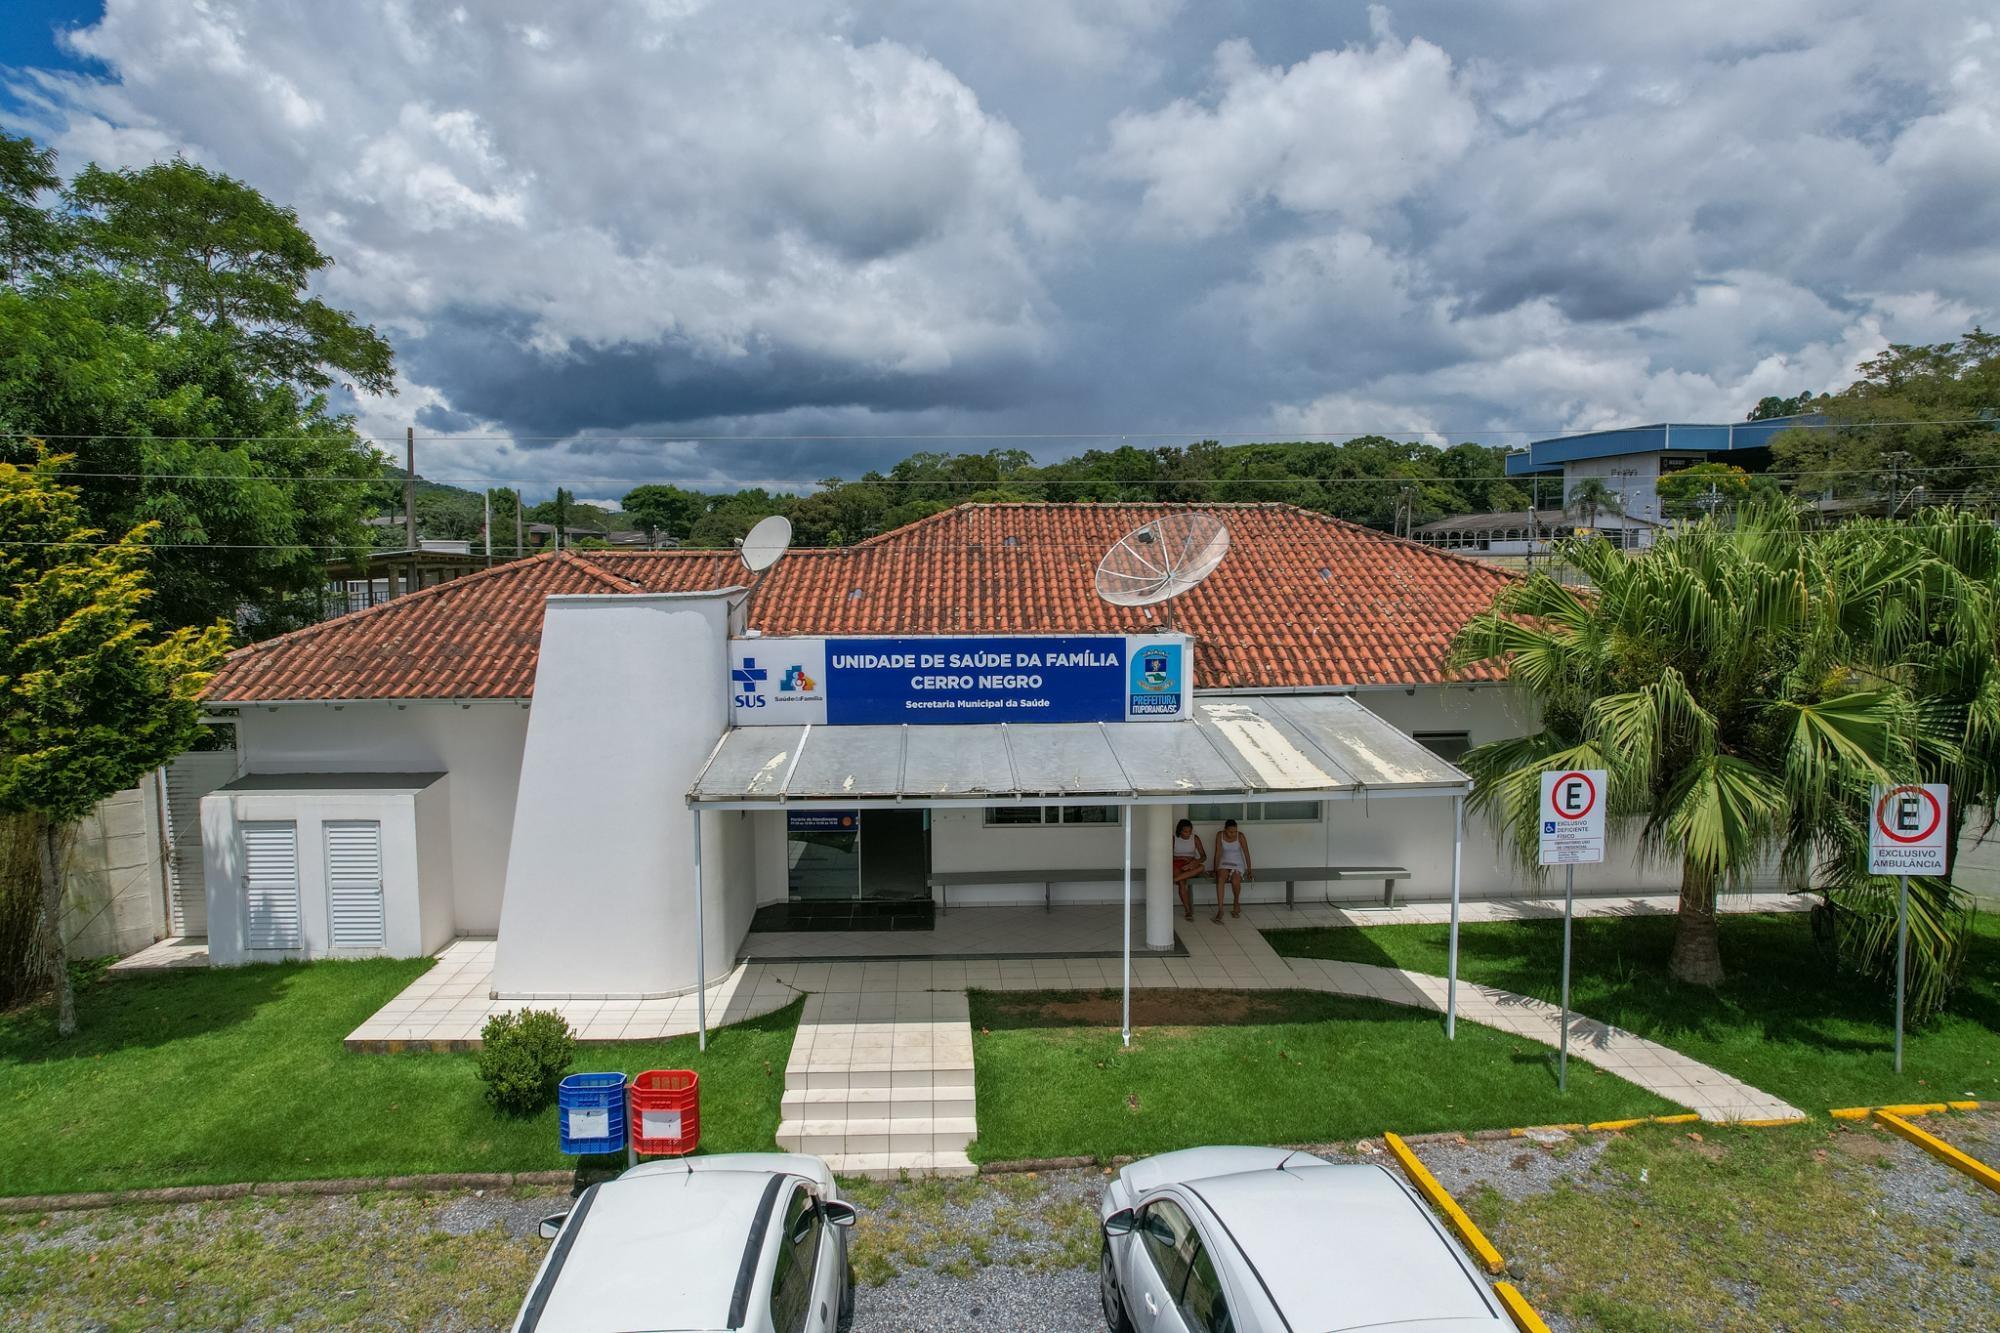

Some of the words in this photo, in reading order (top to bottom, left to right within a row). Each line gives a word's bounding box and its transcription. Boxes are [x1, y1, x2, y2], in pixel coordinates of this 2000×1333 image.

[832, 654, 916, 669] UNIDADE
[920, 653, 945, 668] DE
[949, 650, 1012, 668] SAÚDE
[1016, 653, 1042, 667] DA
[1046, 649, 1119, 667] FAMÍLIA
[911, 675, 974, 690] CERRO
[978, 675, 1043, 689] NEGRO
[735, 694, 766, 708] SUS
[905, 699, 955, 709] Secretaria
[957, 698, 1003, 709] Municipal
[1005, 699, 1018, 708] da
[1020, 698, 1050, 708] Saúde
[1132, 695, 1177, 705] PREFEITURA
[1132, 705, 1178, 714] ITUPORANGA/SC
[1566, 783, 1582, 809] E
[1898, 799, 1920, 830] E
[1878, 849, 1937, 858] EXCLUSIVO
[1872, 858, 1942, 868] AMBULÂNCIA
